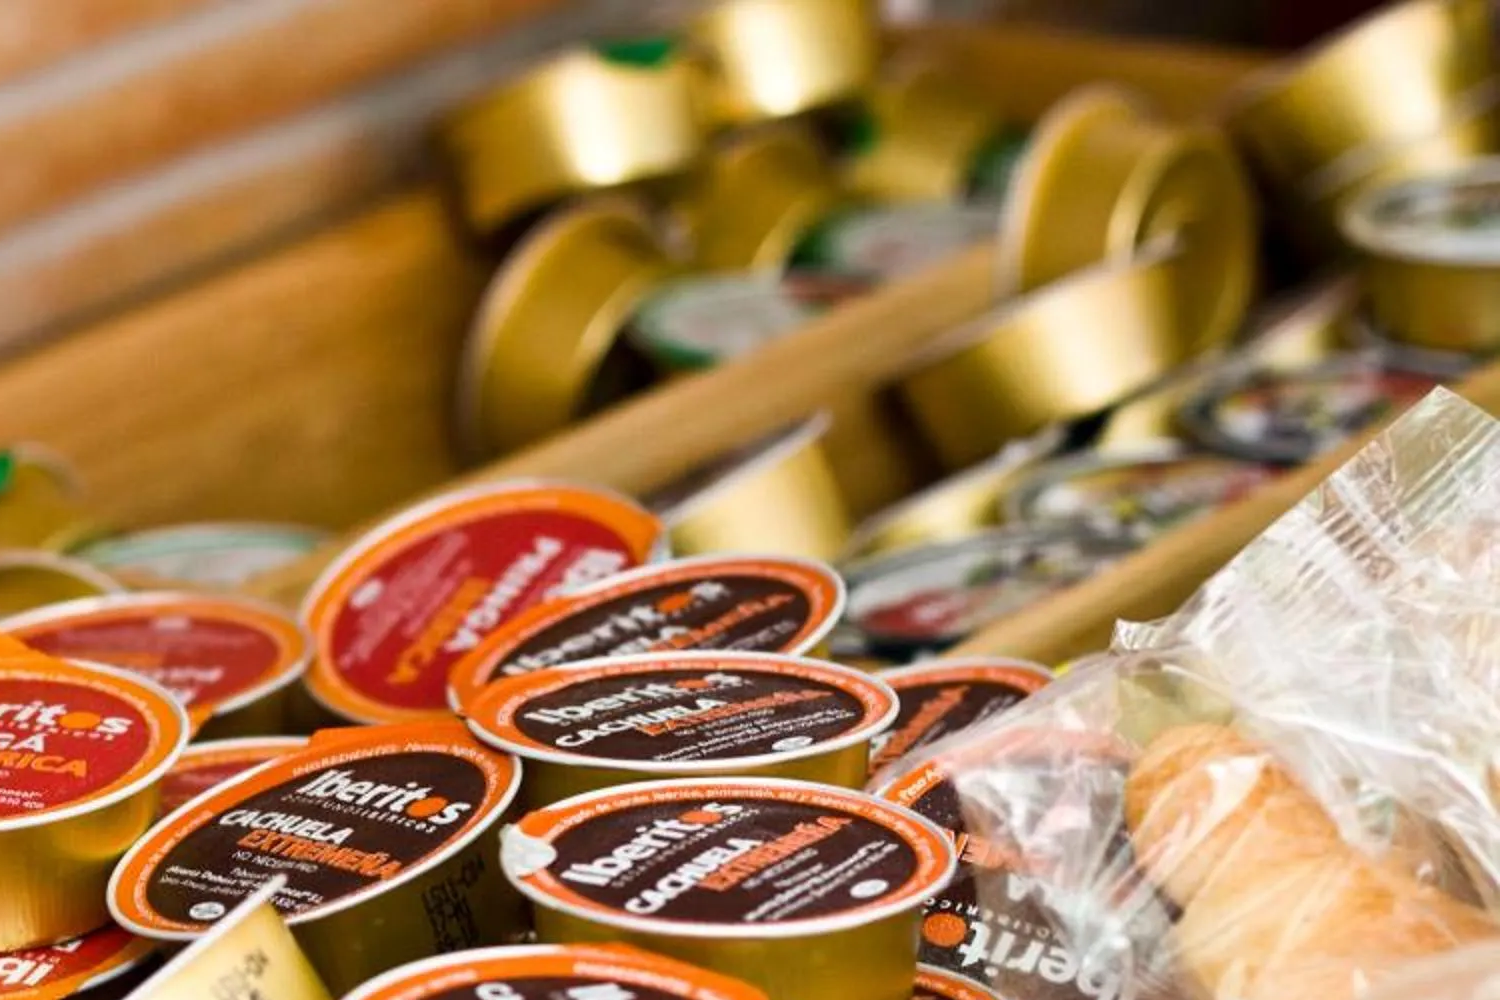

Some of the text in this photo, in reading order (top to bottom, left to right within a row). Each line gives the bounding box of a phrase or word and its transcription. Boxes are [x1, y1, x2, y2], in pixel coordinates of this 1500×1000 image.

[219, 809, 354, 845] CACHUELA
[297, 769, 471, 824] Iberitos
[560, 803, 743, 886] Iberitos
[626, 837, 763, 913] CACHUELA
